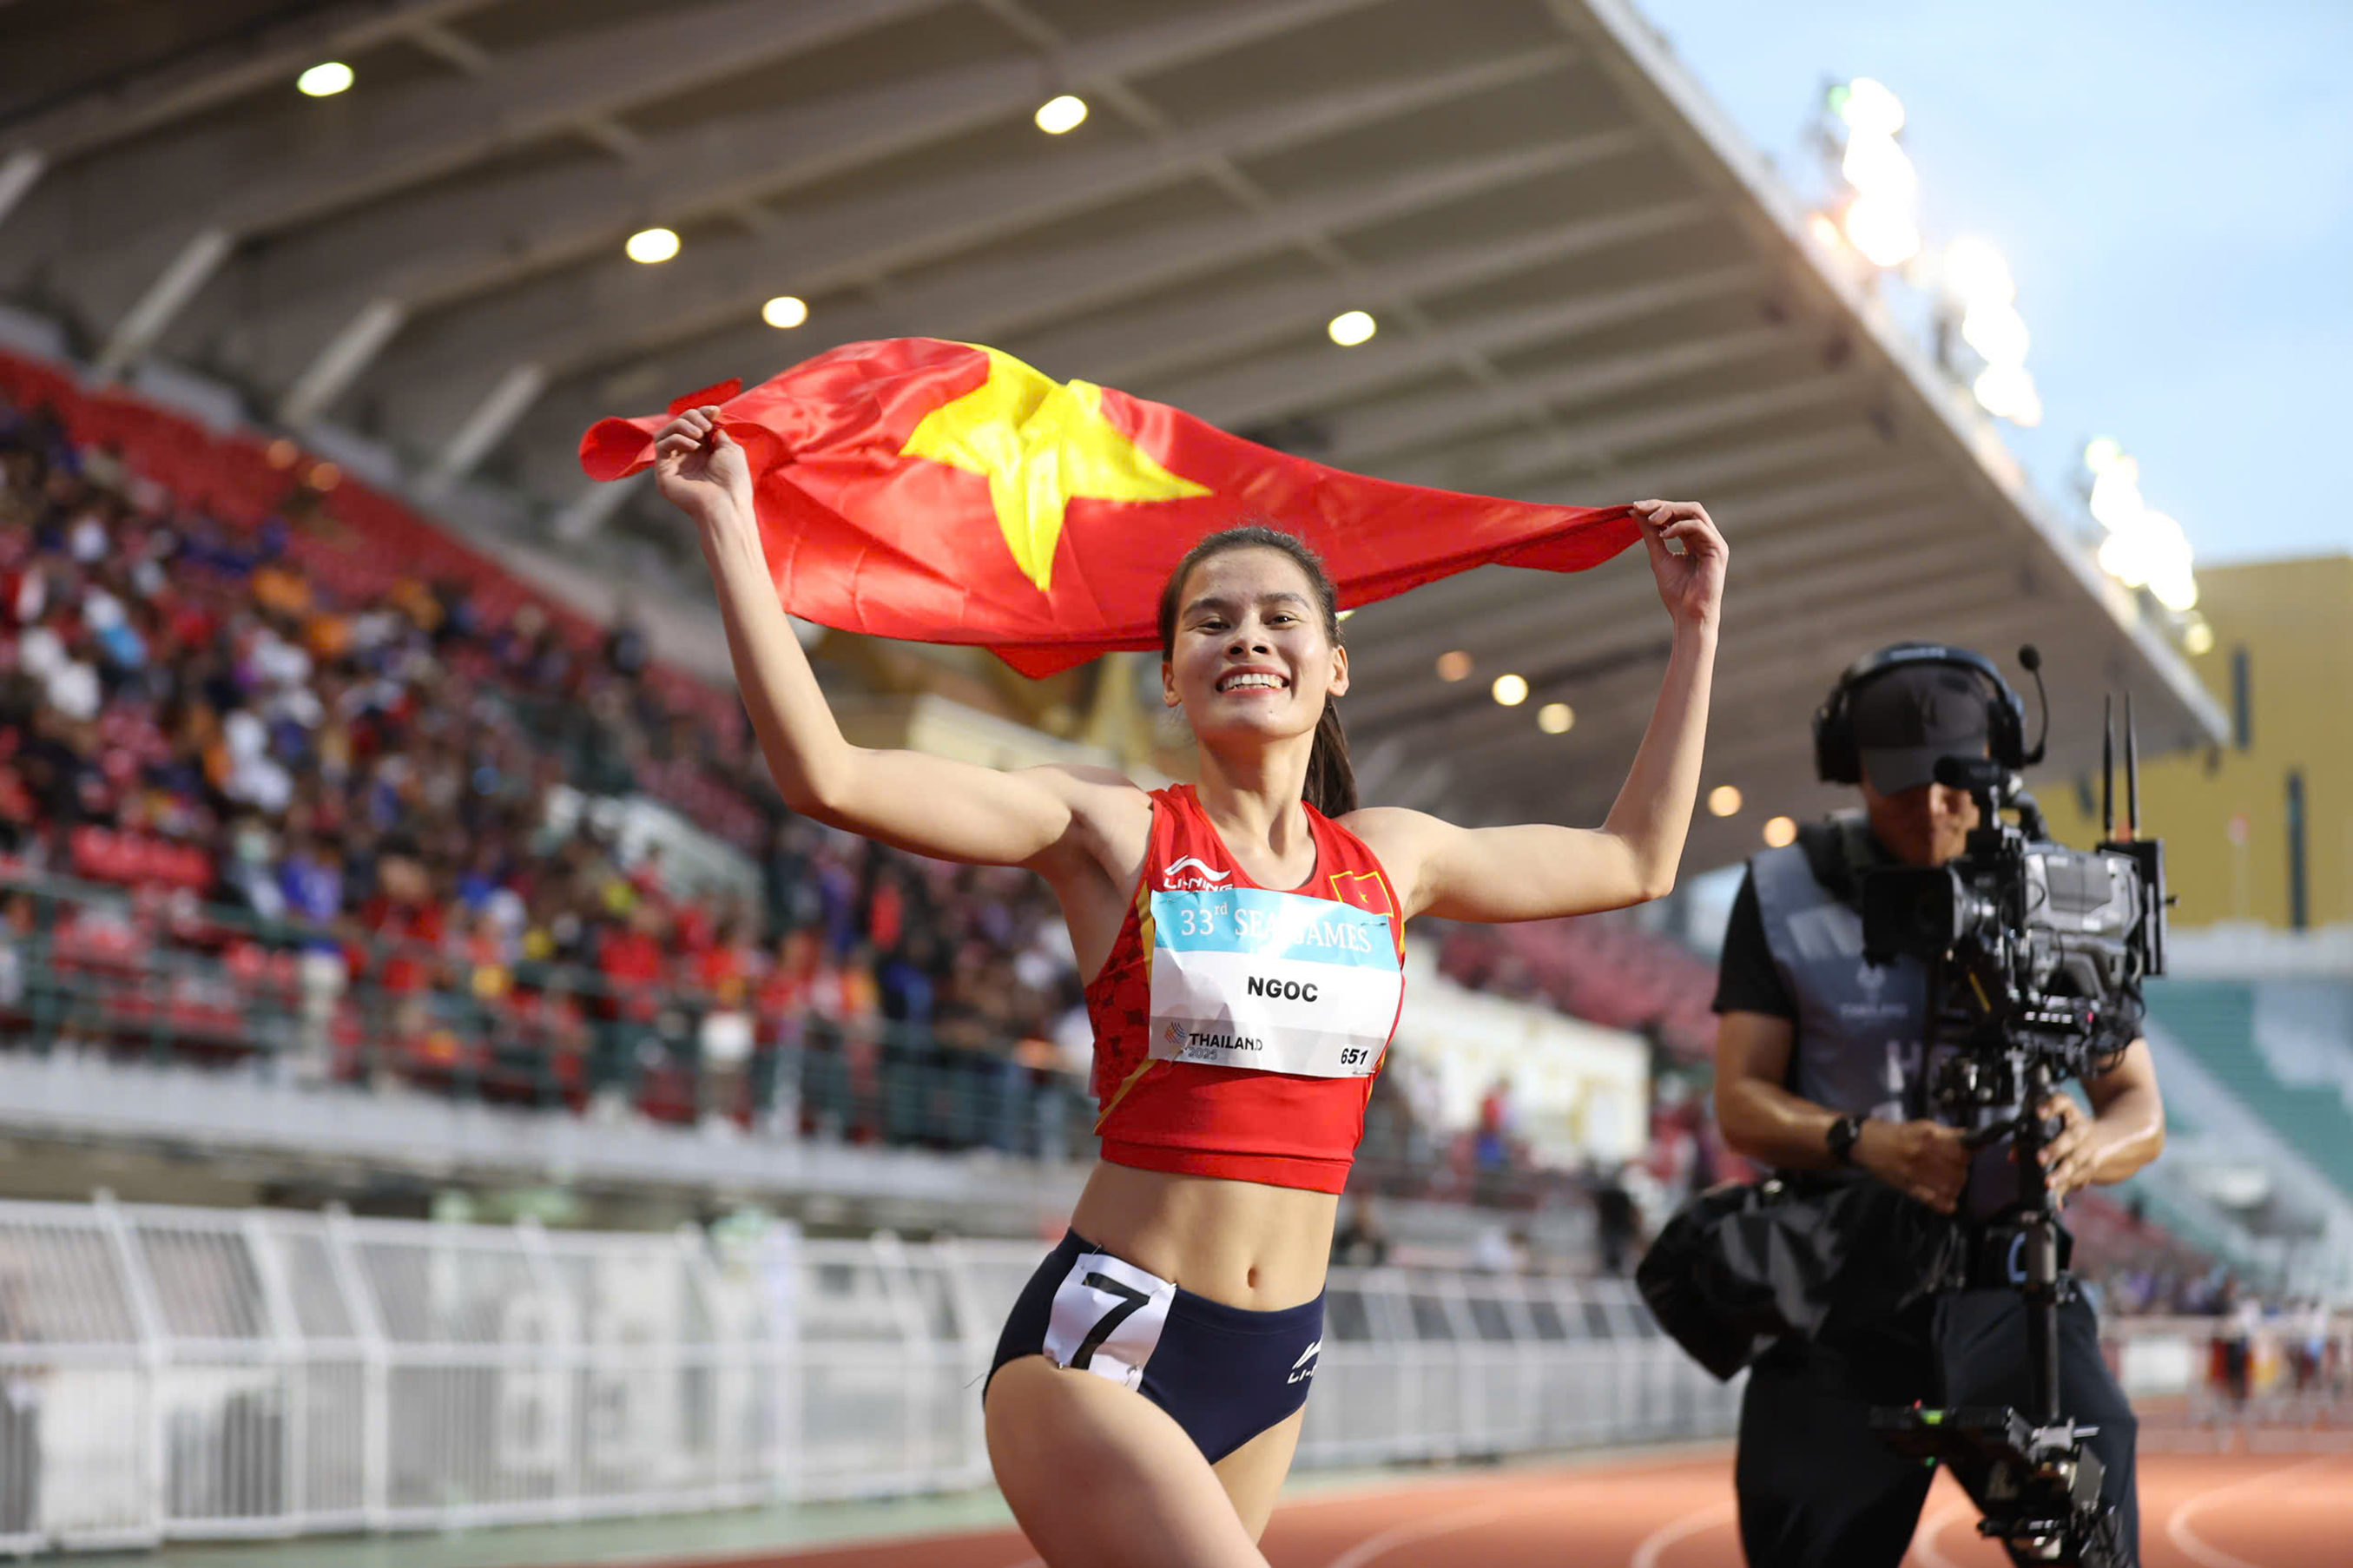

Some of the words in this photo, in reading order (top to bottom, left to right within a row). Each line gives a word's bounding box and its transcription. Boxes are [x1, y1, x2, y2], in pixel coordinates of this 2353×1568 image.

[1181, 901, 1229, 936] 33rd
[1289, 920, 1372, 953] AMES
[1247, 976, 1318, 1003] NGOC
[1188, 1046, 1218, 1060] 2025
[1189, 1033, 1263, 1051] THAILAND
[1341, 1048, 1368, 1065] 651
[1070, 1271, 1150, 1370] 7
